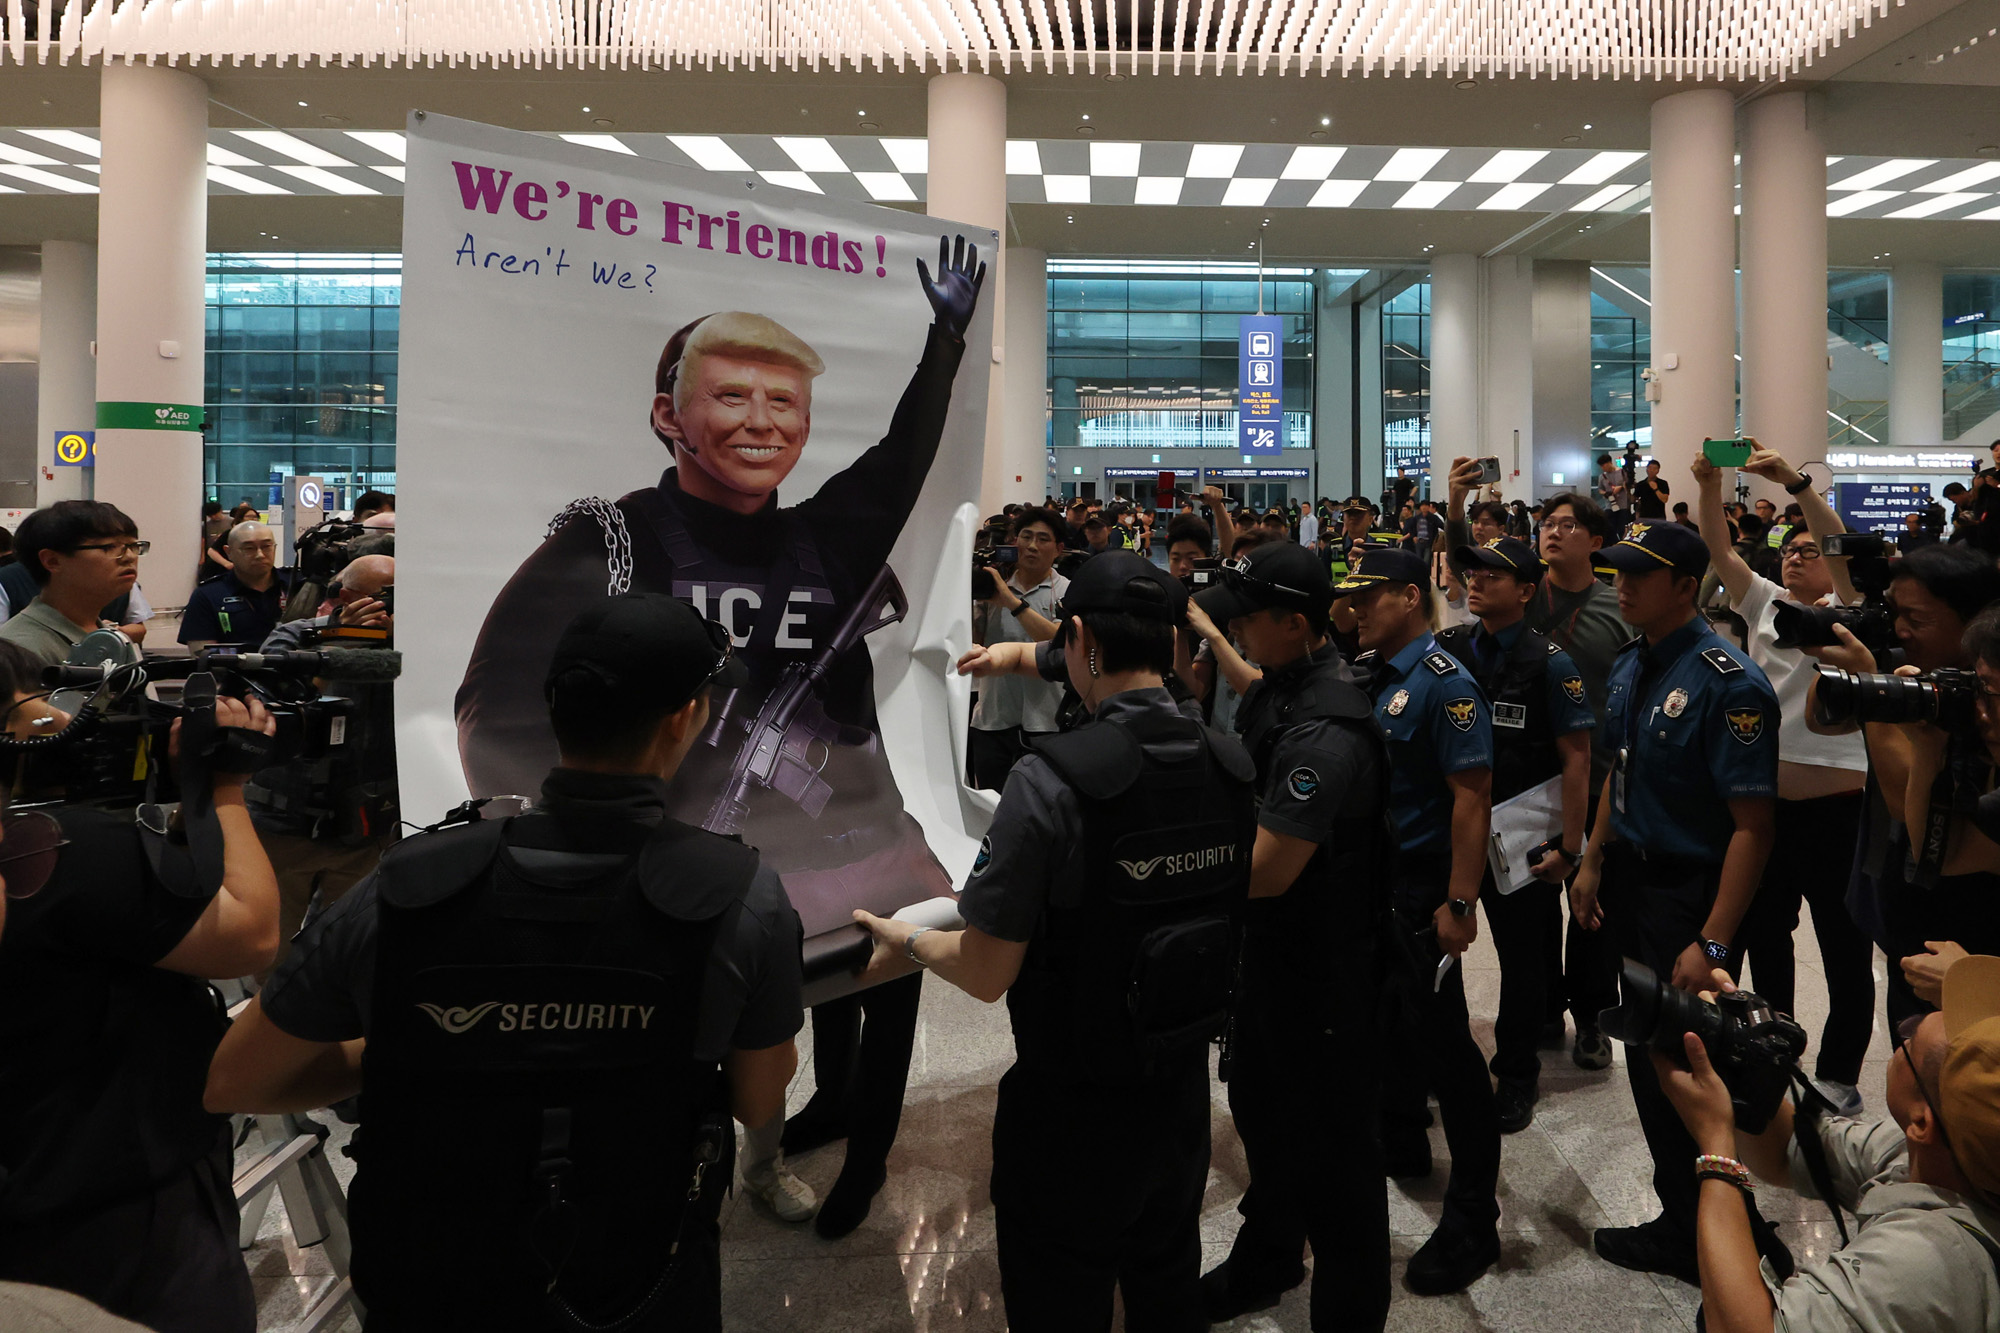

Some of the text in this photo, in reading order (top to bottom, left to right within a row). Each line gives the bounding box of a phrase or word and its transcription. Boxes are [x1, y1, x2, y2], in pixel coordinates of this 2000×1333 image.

[452, 160, 639, 236] We're
[455, 233, 657, 295] Aren't We?
[170, 412, 190, 420] AED
[1247, 427, 1257, 435] B1
[1496, 717, 1520, 725] POLICE
[1924, 813, 1945, 865] SONY
[1164, 843, 1237, 877] SECURITY
[497, 1002, 656, 1033] SECURITY
